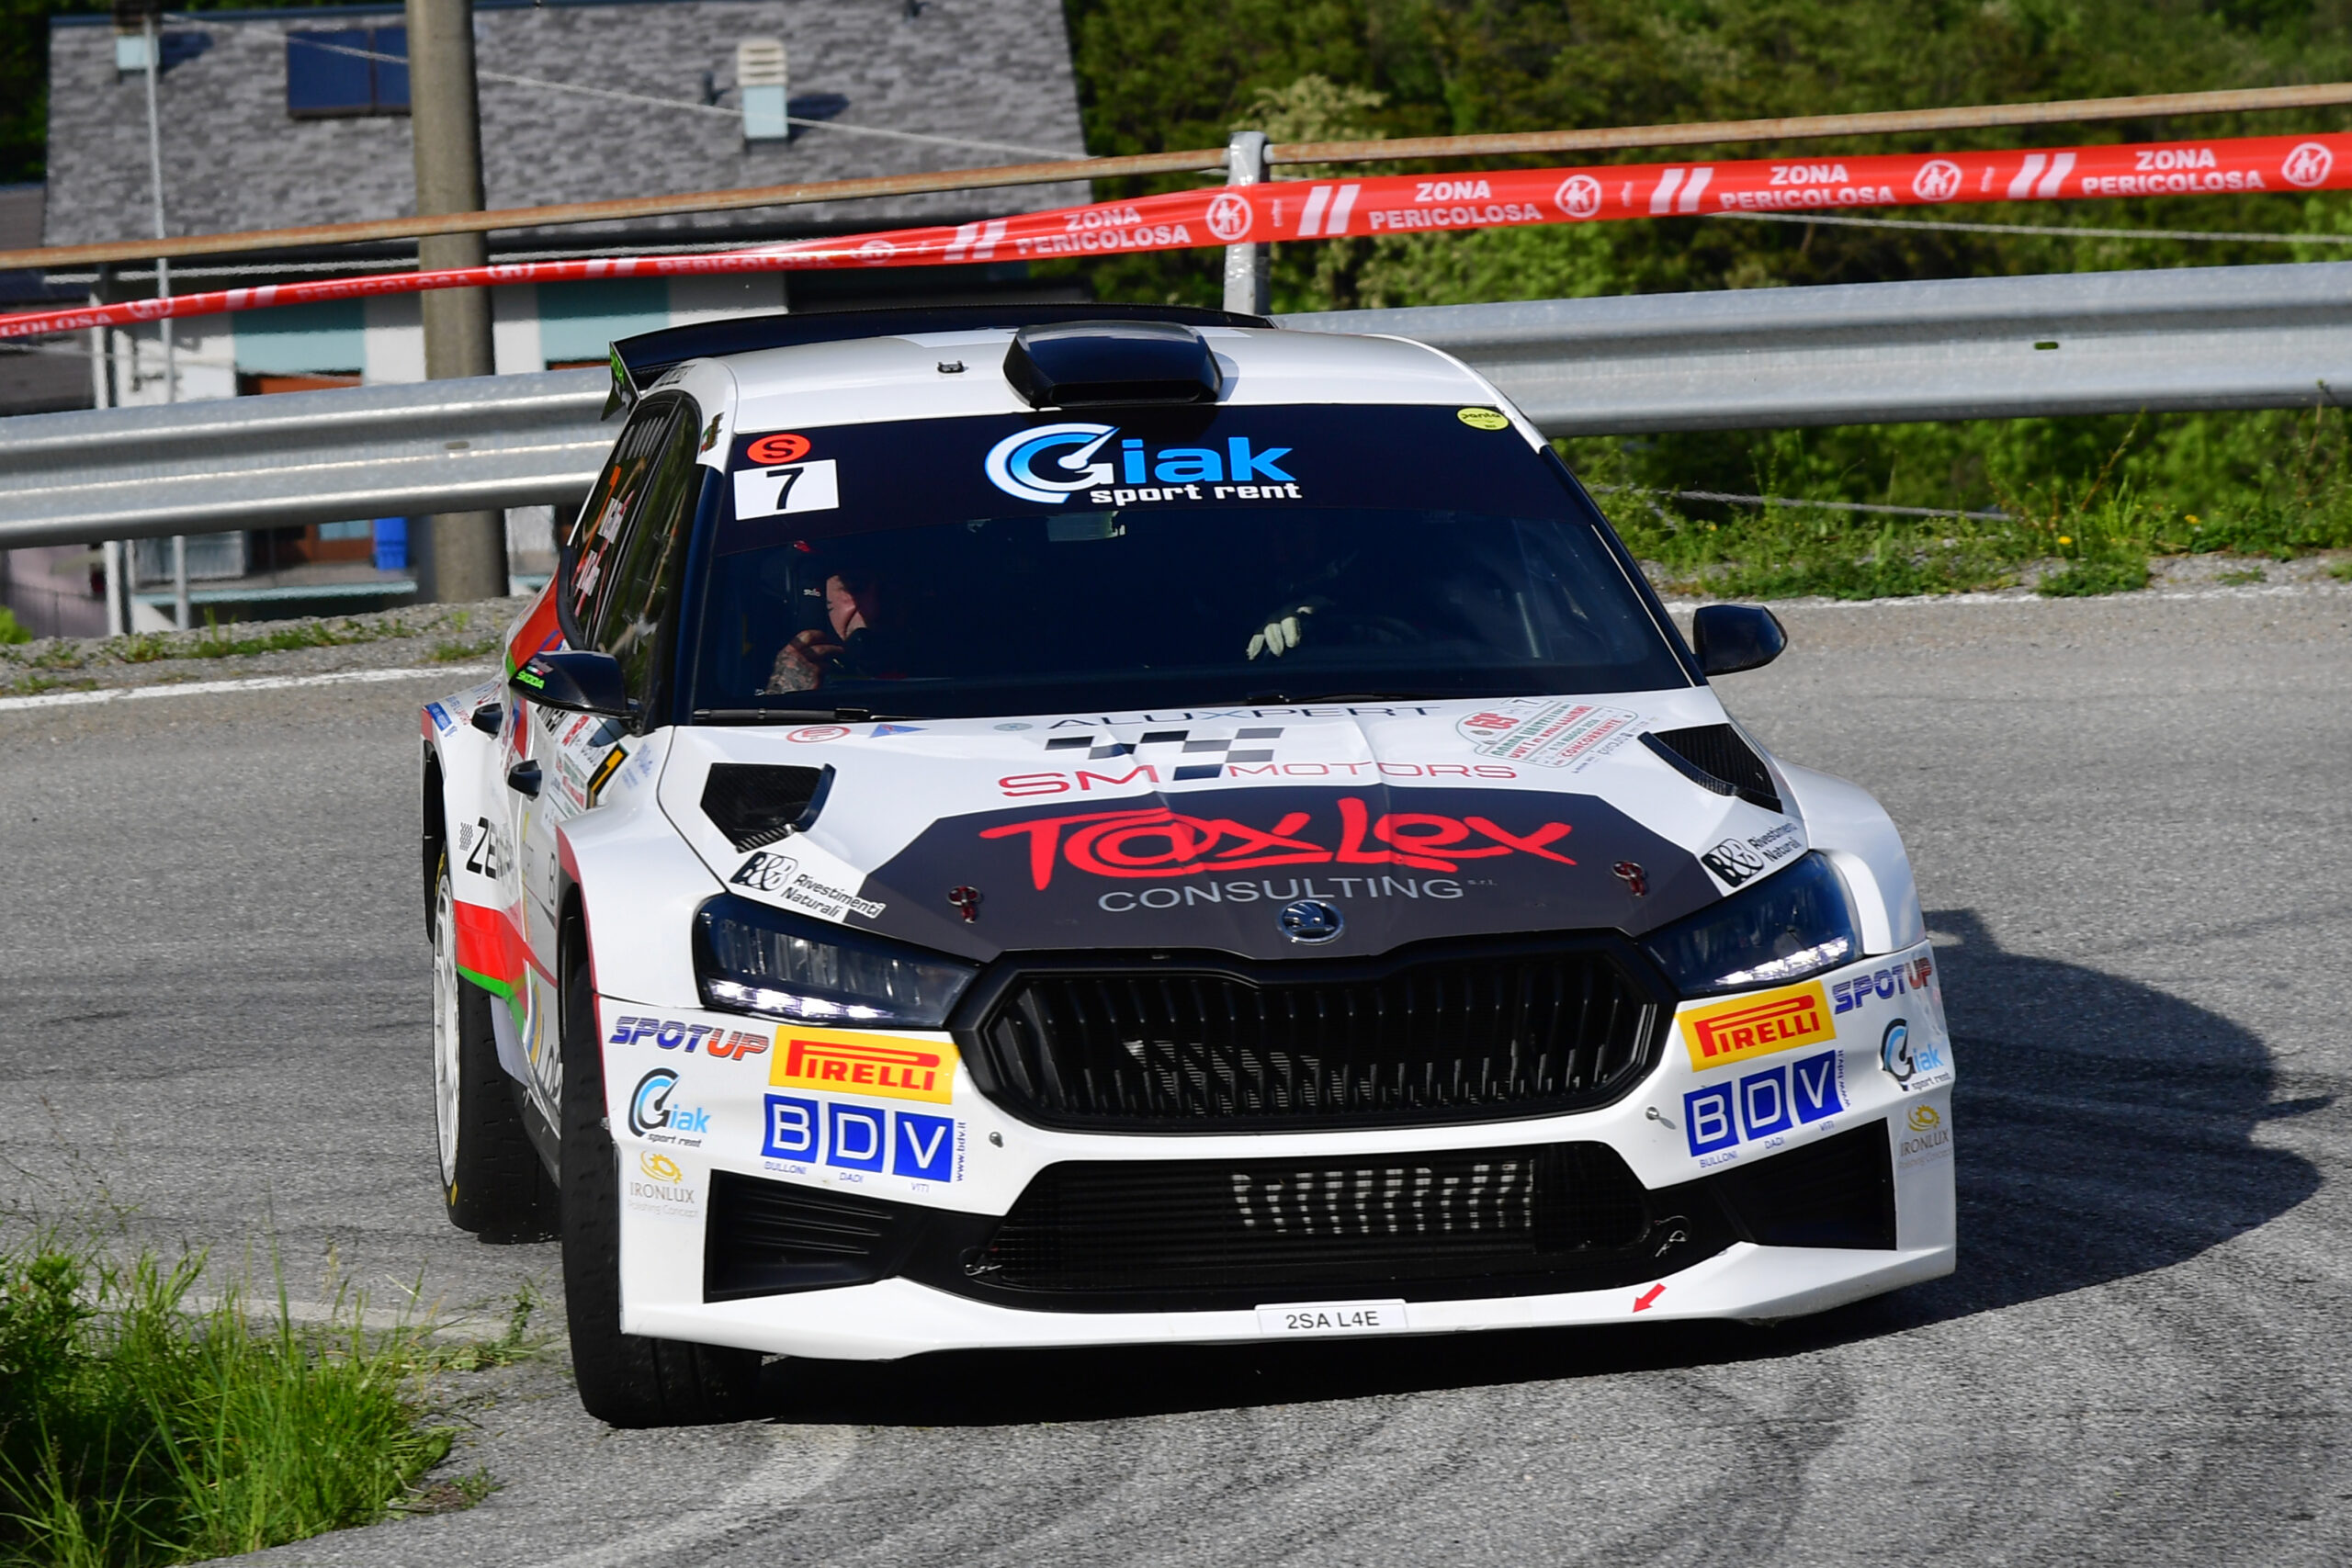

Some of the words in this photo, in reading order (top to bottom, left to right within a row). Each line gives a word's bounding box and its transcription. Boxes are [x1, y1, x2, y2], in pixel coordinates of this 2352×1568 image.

[2135, 149, 2216, 171] ZONA
[1769, 164, 1849, 186] ZONA
[2081, 170, 2265, 195] PERICOLOSA
[1415, 180, 1491, 202] ZONA
[1719, 186, 1896, 210] PERICOLOSA
[1064, 207, 1142, 232] ZONA
[1369, 203, 1544, 230] PERICOLOSA
[1015, 225, 1191, 254] PERICOLOSA
[296, 274, 471, 300] PERICOLOSA
[762, 439, 797, 459] S
[984, 423, 1297, 504] Giak
[765, 467, 804, 510] 7
[1090, 484, 1203, 506] sport
[1213, 482, 1303, 500] rent
[1048, 706, 1441, 729] ALUXPERT
[1561, 718, 1623, 759] CONCORRENTE
[998, 764, 1160, 797] SM
[1227, 761, 1518, 779] MOTORS
[781, 886, 843, 918] Naturali
[793, 874, 883, 917] Rivestimenti
[1098, 875, 1464, 912] CONSULTING
[1831, 957, 1933, 1015] SPOTUP
[1693, 994, 1821, 1058] PIRELLI
[608, 1016, 769, 1062] SPOTUP
[786, 1039, 940, 1091] PIRELLI
[1881, 1018, 1944, 1092] Giak
[1911, 1077, 1933, 1092] sport
[1934, 1071, 1951, 1085] rent
[628, 1066, 712, 1138] Giak
[647, 1133, 677, 1145] sport
[678, 1136, 703, 1148] rent
[956, 1122, 967, 1182] www.bdv.it
[1763, 1137, 1785, 1149] DADI
[1900, 1129, 1950, 1157] IRONLUX
[763, 1160, 807, 1176] BULLONI
[1700, 1150, 1739, 1168] BULLONI
[839, 1172, 865, 1184] DADI
[910, 1182, 930, 1194] VITI
[628, 1181, 695, 1204] IRONLUX
[1286, 1313, 1331, 1330] 2SA
[1337, 1311, 1380, 1328] L4E
